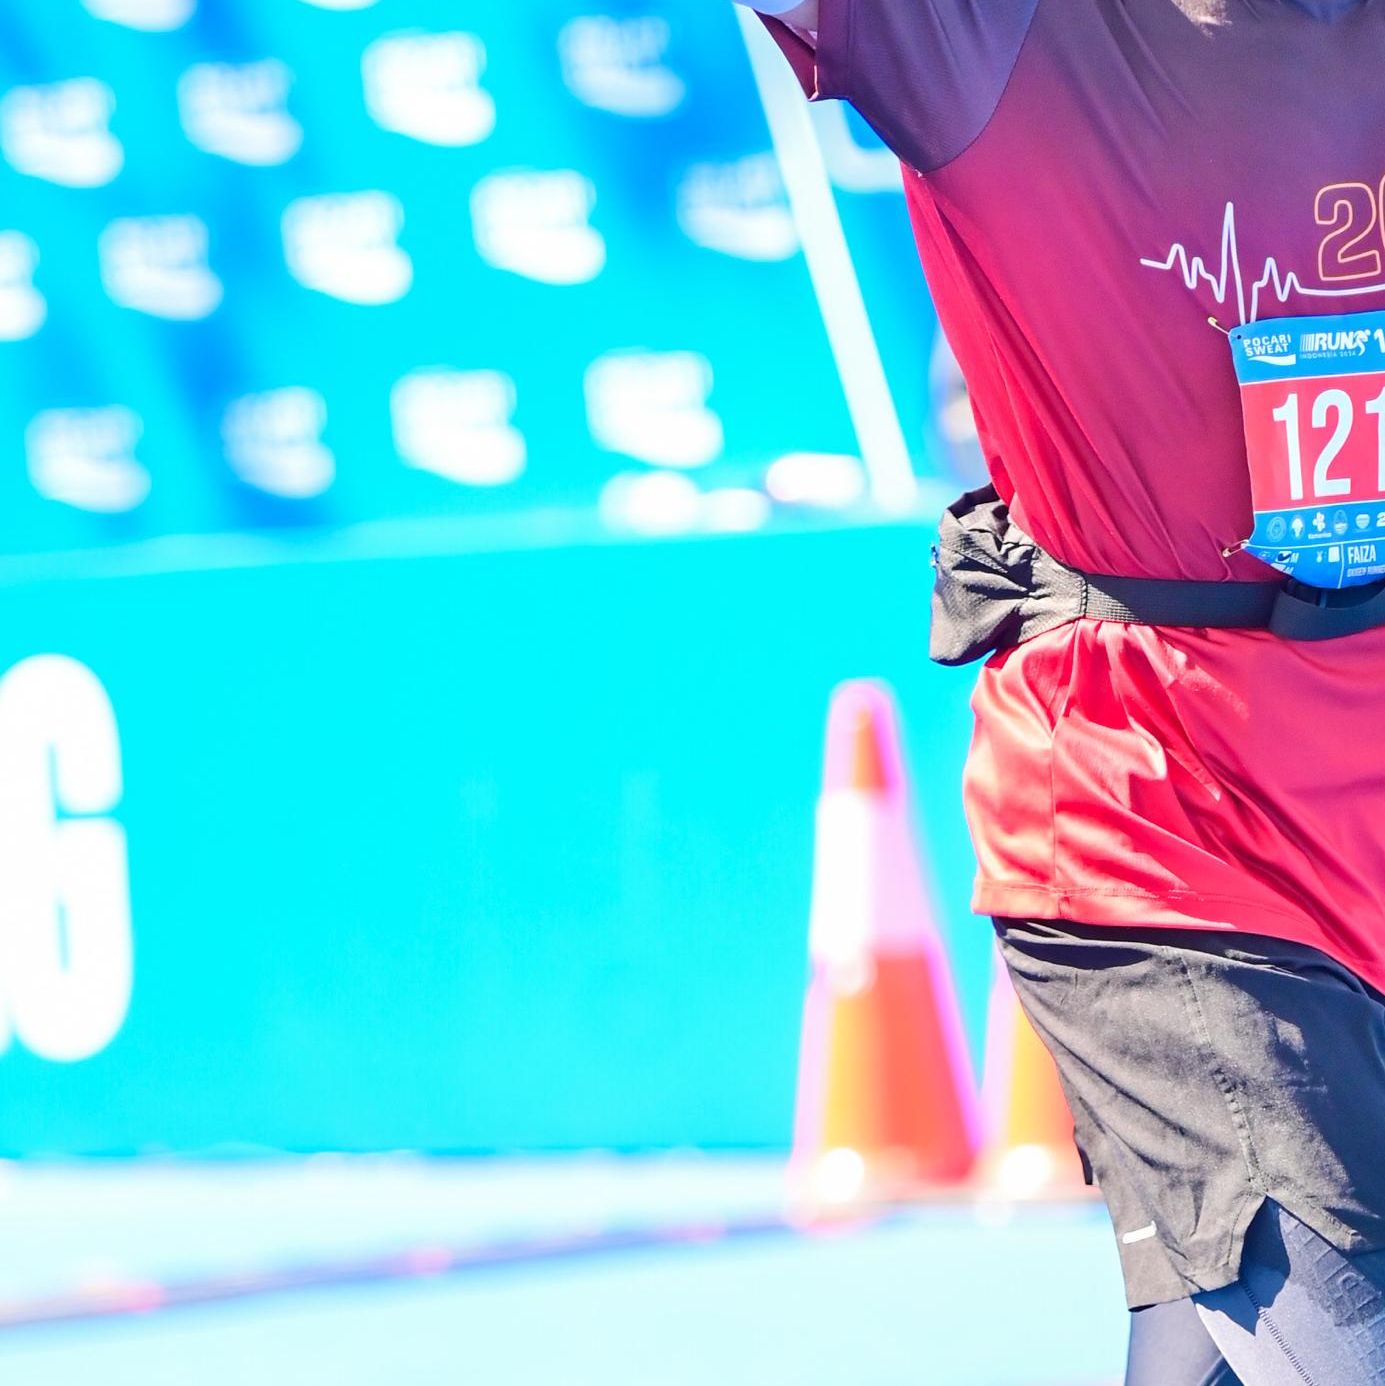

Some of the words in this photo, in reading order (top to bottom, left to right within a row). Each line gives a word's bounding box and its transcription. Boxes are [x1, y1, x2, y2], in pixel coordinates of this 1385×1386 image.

[1243, 333, 1292, 349] POCARI
[1245, 343, 1289, 357] SWEAT
[1347, 544, 1377, 565] FAIZA
